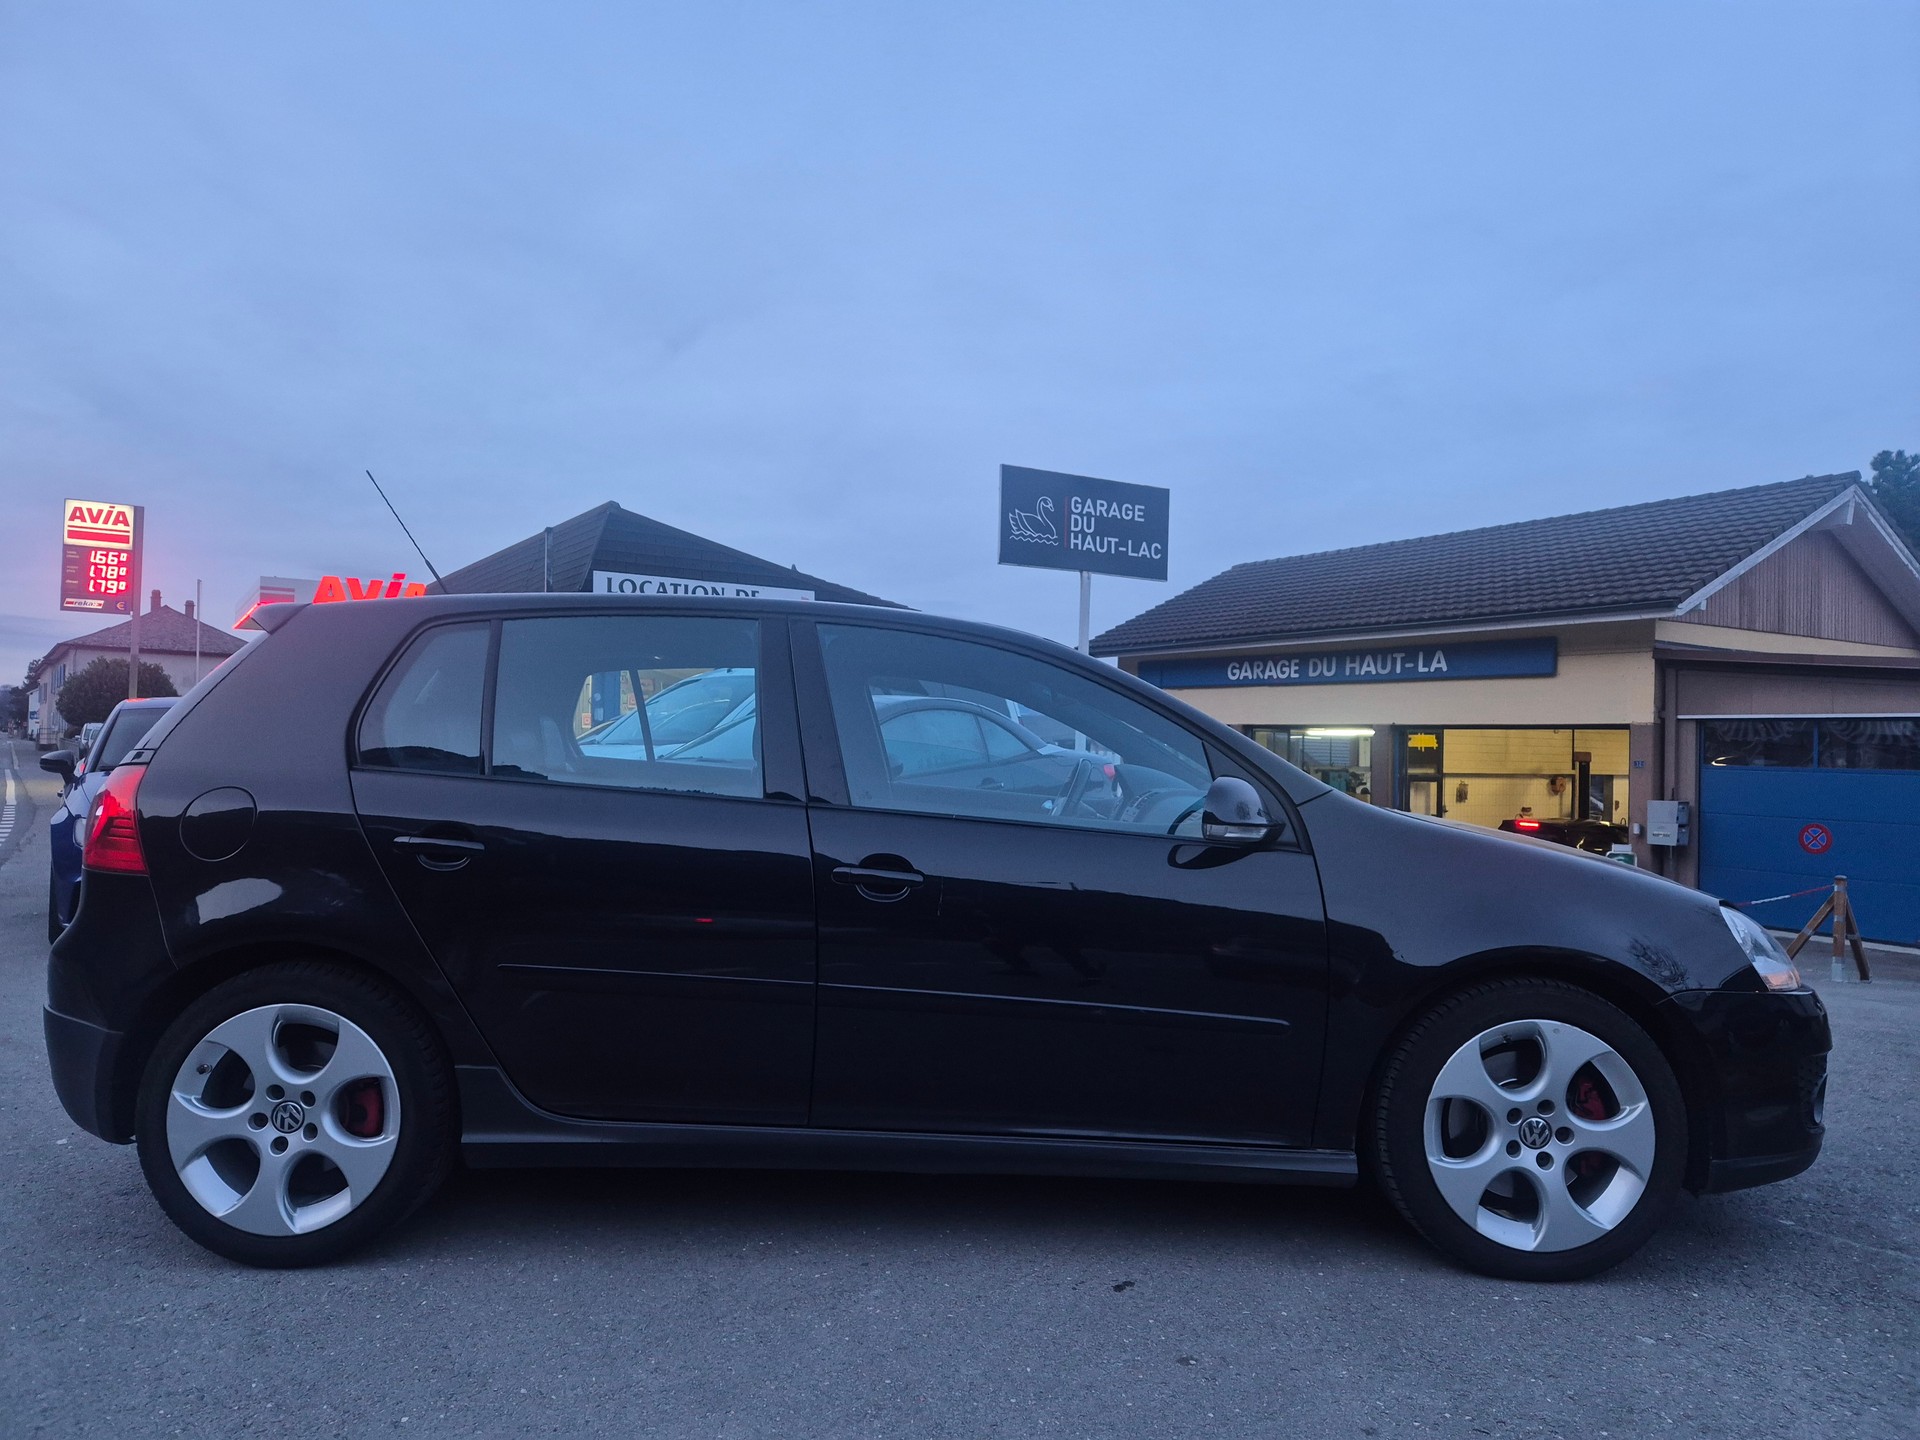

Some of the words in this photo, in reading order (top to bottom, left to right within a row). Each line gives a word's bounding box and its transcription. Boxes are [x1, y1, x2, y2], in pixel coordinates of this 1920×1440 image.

[1070, 496, 1145, 522] GARAGE
[1070, 514, 1095, 533] DU
[1070, 533, 1162, 560] HAUT-LAC
[606, 577, 725, 596] LOCATION
[1227, 658, 1299, 680] GARAGE
[1308, 656, 1336, 677] DU
[1345, 650, 1448, 676] HAUT-LA
